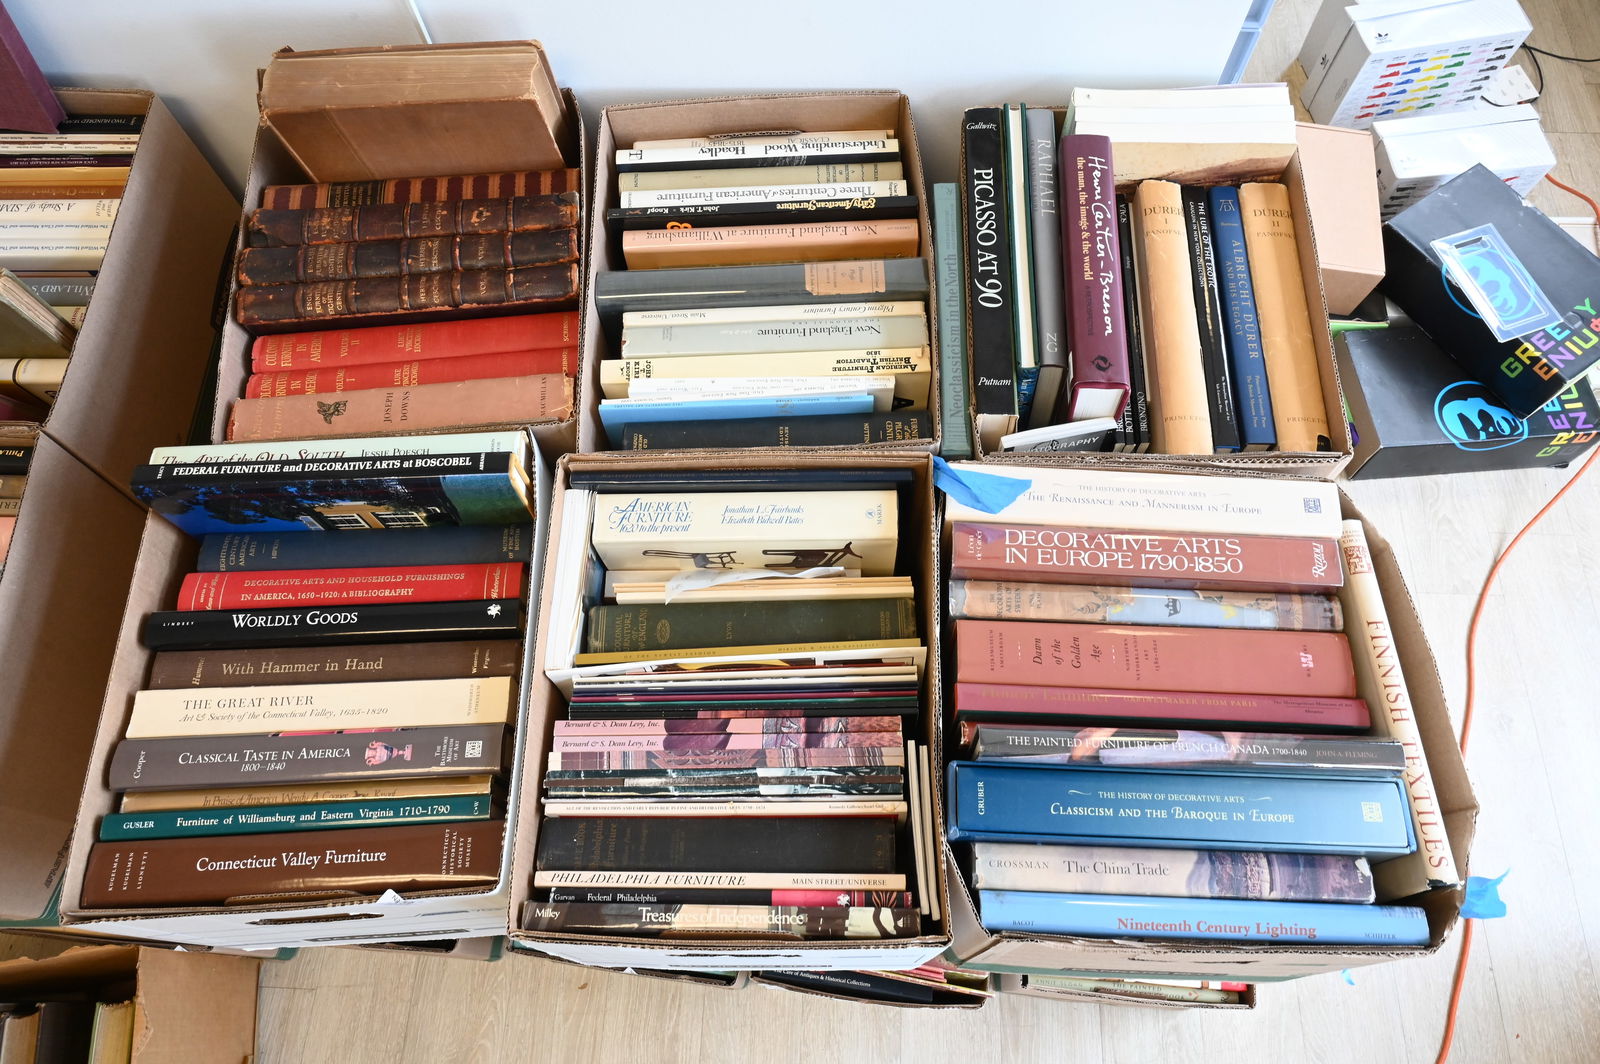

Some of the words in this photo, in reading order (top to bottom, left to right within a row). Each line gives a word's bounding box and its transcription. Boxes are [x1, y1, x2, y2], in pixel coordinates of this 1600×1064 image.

[966, 121, 997, 130] Gallwitz
[698, 146, 746, 157] Hoadley
[764, 143, 798, 155] Wood
[801, 140, 886, 154] Understanding
[1037, 139, 1055, 216] RAPHAEL
[1088, 156, 1111, 204] Henri
[657, 192, 713, 202] Furniture
[716, 190, 771, 200] American
[780, 187, 836, 198] Centuries
[840, 186, 875, 196] Three
[26, 202, 36, 212] of
[39, 202, 63, 212] Study
[66, 203, 76, 211] A
[974, 168, 997, 246] PICASSO
[646, 230, 724, 241] Williamsburg
[727, 230, 738, 238] at
[740, 227, 795, 239] Furniture
[799, 223, 847, 237] England
[852, 224, 878, 235] New
[977, 249, 998, 275] AT
[975, 278, 1003, 308] 90
[1232, 240, 1250, 307] ALBRECHT
[1243, 314, 1259, 359] DÜRER
[867, 305, 894, 313] Pilgrim
[978, 377, 1011, 386] Putnam
[384, 392, 393, 423] JOSEPH
[401, 391, 410, 421] DOWNS
[173, 464, 218, 476] FEDERAL
[220, 464, 281, 474] FURNITURE
[282, 463, 301, 472] and
[304, 460, 374, 471] DECORATIVE
[374, 460, 400, 469] ARTS
[403, 460, 413, 468] at
[415, 457, 472, 468] BOSCOBEL
[614, 498, 692, 512] AMERICAN
[1024, 491, 1044, 502] THE
[1049, 493, 1114, 506] RENAISSANCE
[1142, 499, 1204, 511] MANNERISM
[1221, 503, 1262, 515] EUROPE
[608, 511, 692, 529] FURNITURE
[1005, 529, 1162, 552] DECORATIVE
[1173, 537, 1242, 555] ARTS
[1005, 548, 1027, 564] IN
[1037, 548, 1134, 569] EUROPE
[1140, 553, 1243, 573] 1790-1850
[244, 578, 300, 587] DECORATIVE
[348, 575, 402, 583] HOUSEHOLD
[405, 574, 465, 582] FURNISHINGS
[254, 593, 295, 601] AMERICA,
[349, 588, 414, 598] BIBLIOGRAPHY
[232, 614, 302, 628] WORLDLY
[306, 611, 358, 625] GOODS
[1033, 638, 1042, 665] Dawn
[1051, 638, 1061, 652] the
[1071, 636, 1081, 669] Golden
[1050, 653, 1064, 665] of
[1090, 644, 1102, 662] Age
[222, 663, 253, 675] With
[259, 661, 320, 674] Hammer
[325, 660, 338, 671] in
[345, 657, 383, 670] Hand
[183, 699, 212, 710] THE
[217, 698, 264, 709] GREAT
[270, 695, 314, 706] RIVER
[1007, 736, 1030, 746] THE
[1033, 737, 1083, 748] PAINTED
[1086, 738, 1150, 749] FURNITURE
[1153, 740, 1169, 750] OF
[1172, 742, 1220, 754] FRENCH
[1225, 744, 1269, 755] CANADA
[1272, 748, 1307, 756] 1700-1840
[1366, 619, 1410, 724] FINNISH
[1402, 736, 1448, 868] TEXTILES
[179, 752, 239, 764] CLASSICAL
[243, 750, 278, 761] TASTE
[282, 750, 294, 760] IN
[298, 748, 351, 759] AMERICA
[133, 750, 146, 779] Cooper
[977, 781, 985, 815] GRUBER
[1098, 791, 1115, 799] THE
[1117, 792, 1153, 800] HISTORY
[1168, 793, 1222, 803] DECORATIVE
[1224, 795, 1245, 803] ARTS
[176, 818, 219, 826] Furniture
[224, 816, 233, 824] of
[238, 814, 296, 824] Williamsburg
[300, 812, 316, 820] and
[321, 811, 354, 819] Eastern
[359, 809, 393, 819] Virginia
[1050, 802, 1113, 816] CLASSICISM
[1118, 808, 1141, 817] AND
[1145, 809, 1167, 818] THE
[1171, 807, 1228, 822] BAROQUE
[1233, 812, 1244, 821] IN
[1249, 809, 1295, 823] EUROPE
[123, 821, 154, 829] GUSLER
[196, 855, 277, 872] Connecticut
[282, 853, 321, 869] Valley
[324, 849, 387, 864] Furniture
[988, 860, 1049, 869] CROSSMAN
[1063, 860, 1090, 874] The
[1093, 861, 1130, 875] China
[1135, 862, 1169, 876] Trade
[550, 873, 660, 885] PHILADELPHIA
[664, 874, 746, 886] FURNITURE
[587, 893, 612, 901] Federal
[616, 893, 657, 903] Philadelphia
[535, 907, 560, 919] Milley
[638, 907, 698, 922] Treasures
[700, 908, 713, 922] of
[715, 908, 804, 926] Independence
[1117, 918, 1192, 932] Nineteenth
[1196, 920, 1250, 936] Century
[1255, 922, 1317, 939] Lighting
[800, 972, 820, 980] Antiques
[825, 975, 846, 983] Historical
[847, 979, 871, 987] Collections
